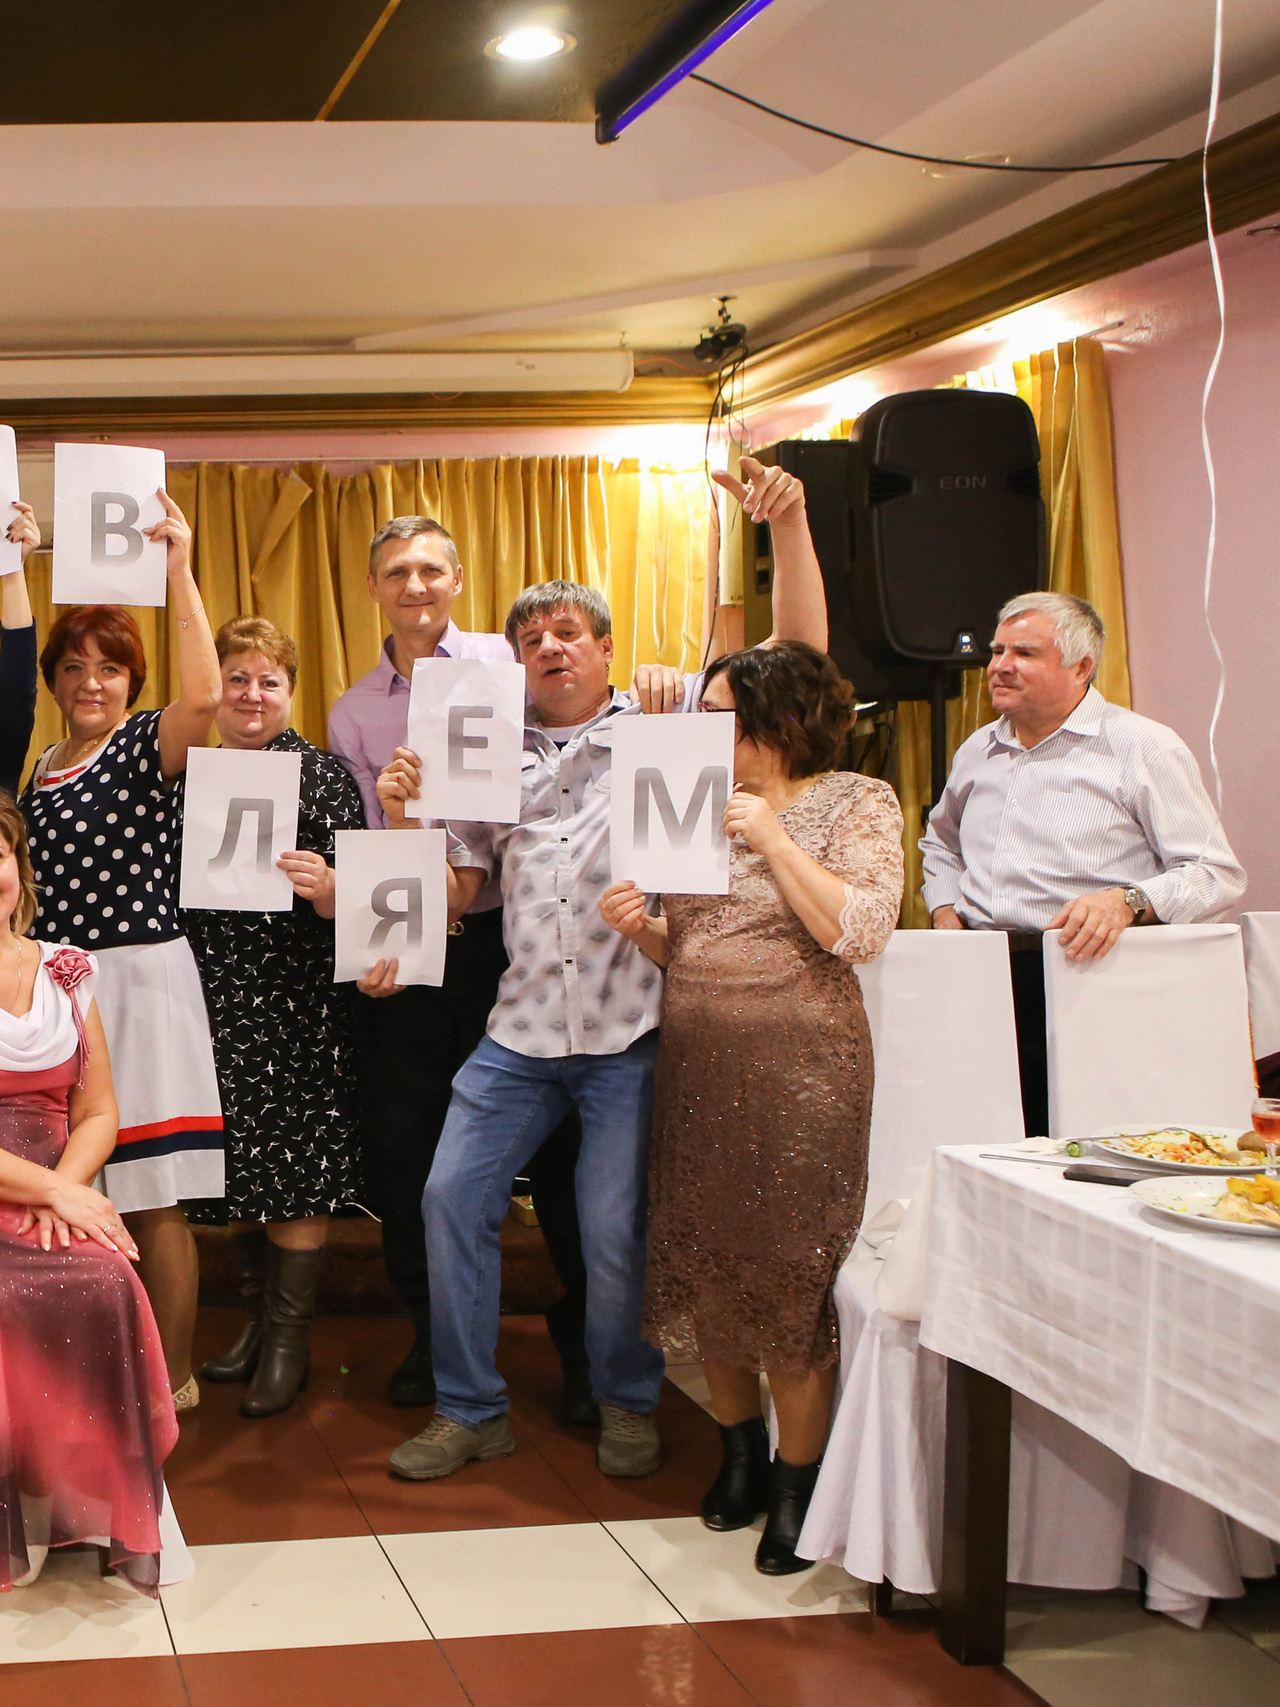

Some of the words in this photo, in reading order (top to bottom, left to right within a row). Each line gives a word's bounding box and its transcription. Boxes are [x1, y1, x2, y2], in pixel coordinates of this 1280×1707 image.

[939, 475, 987, 490] EON
[90, 491, 144, 567] В
[447, 705, 494, 782] Е
[207, 797, 275, 874] Л
[632, 765, 728, 852] М
[367, 877, 423, 950] Я
